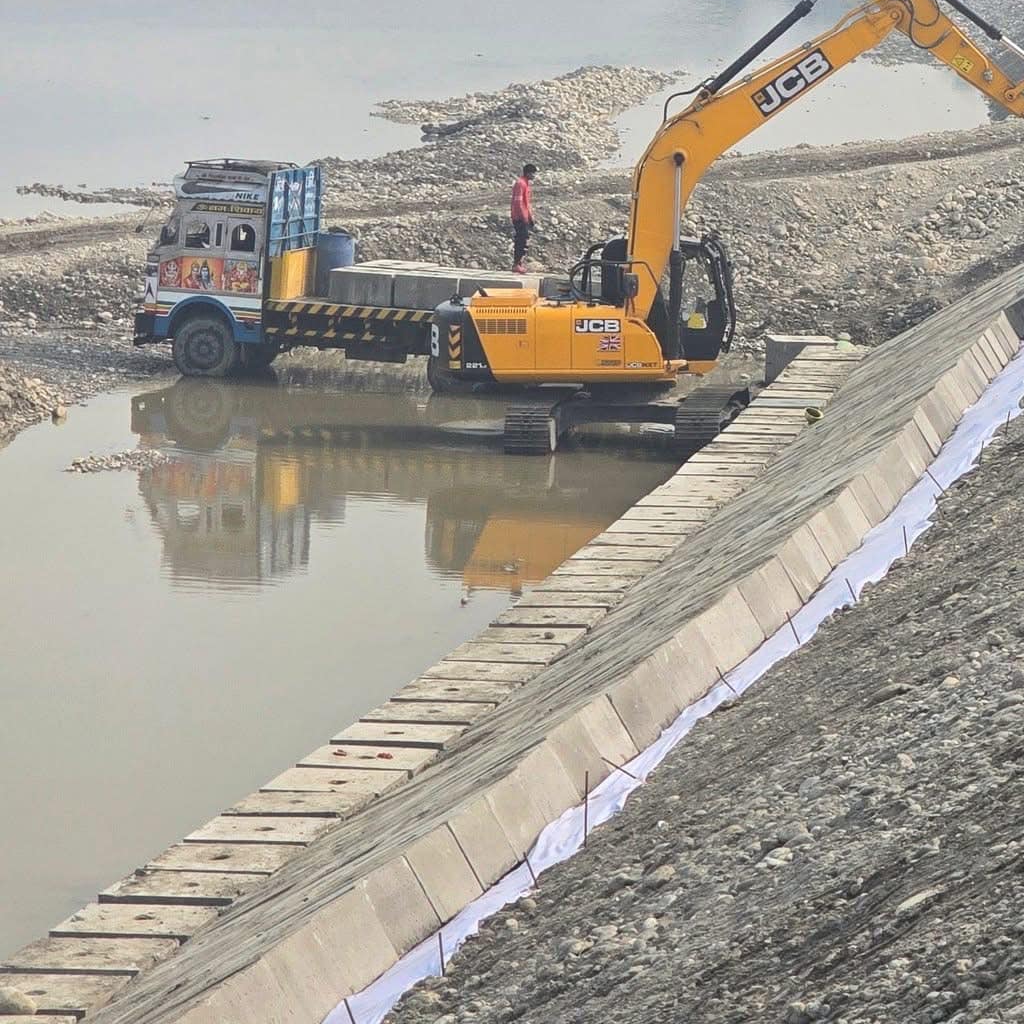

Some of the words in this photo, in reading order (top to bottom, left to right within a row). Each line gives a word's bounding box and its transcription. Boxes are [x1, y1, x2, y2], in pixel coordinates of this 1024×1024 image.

[759, 52, 830, 113] JCB
[235, 192, 260, 201] NIKE
[575, 319, 620, 332] JCB
